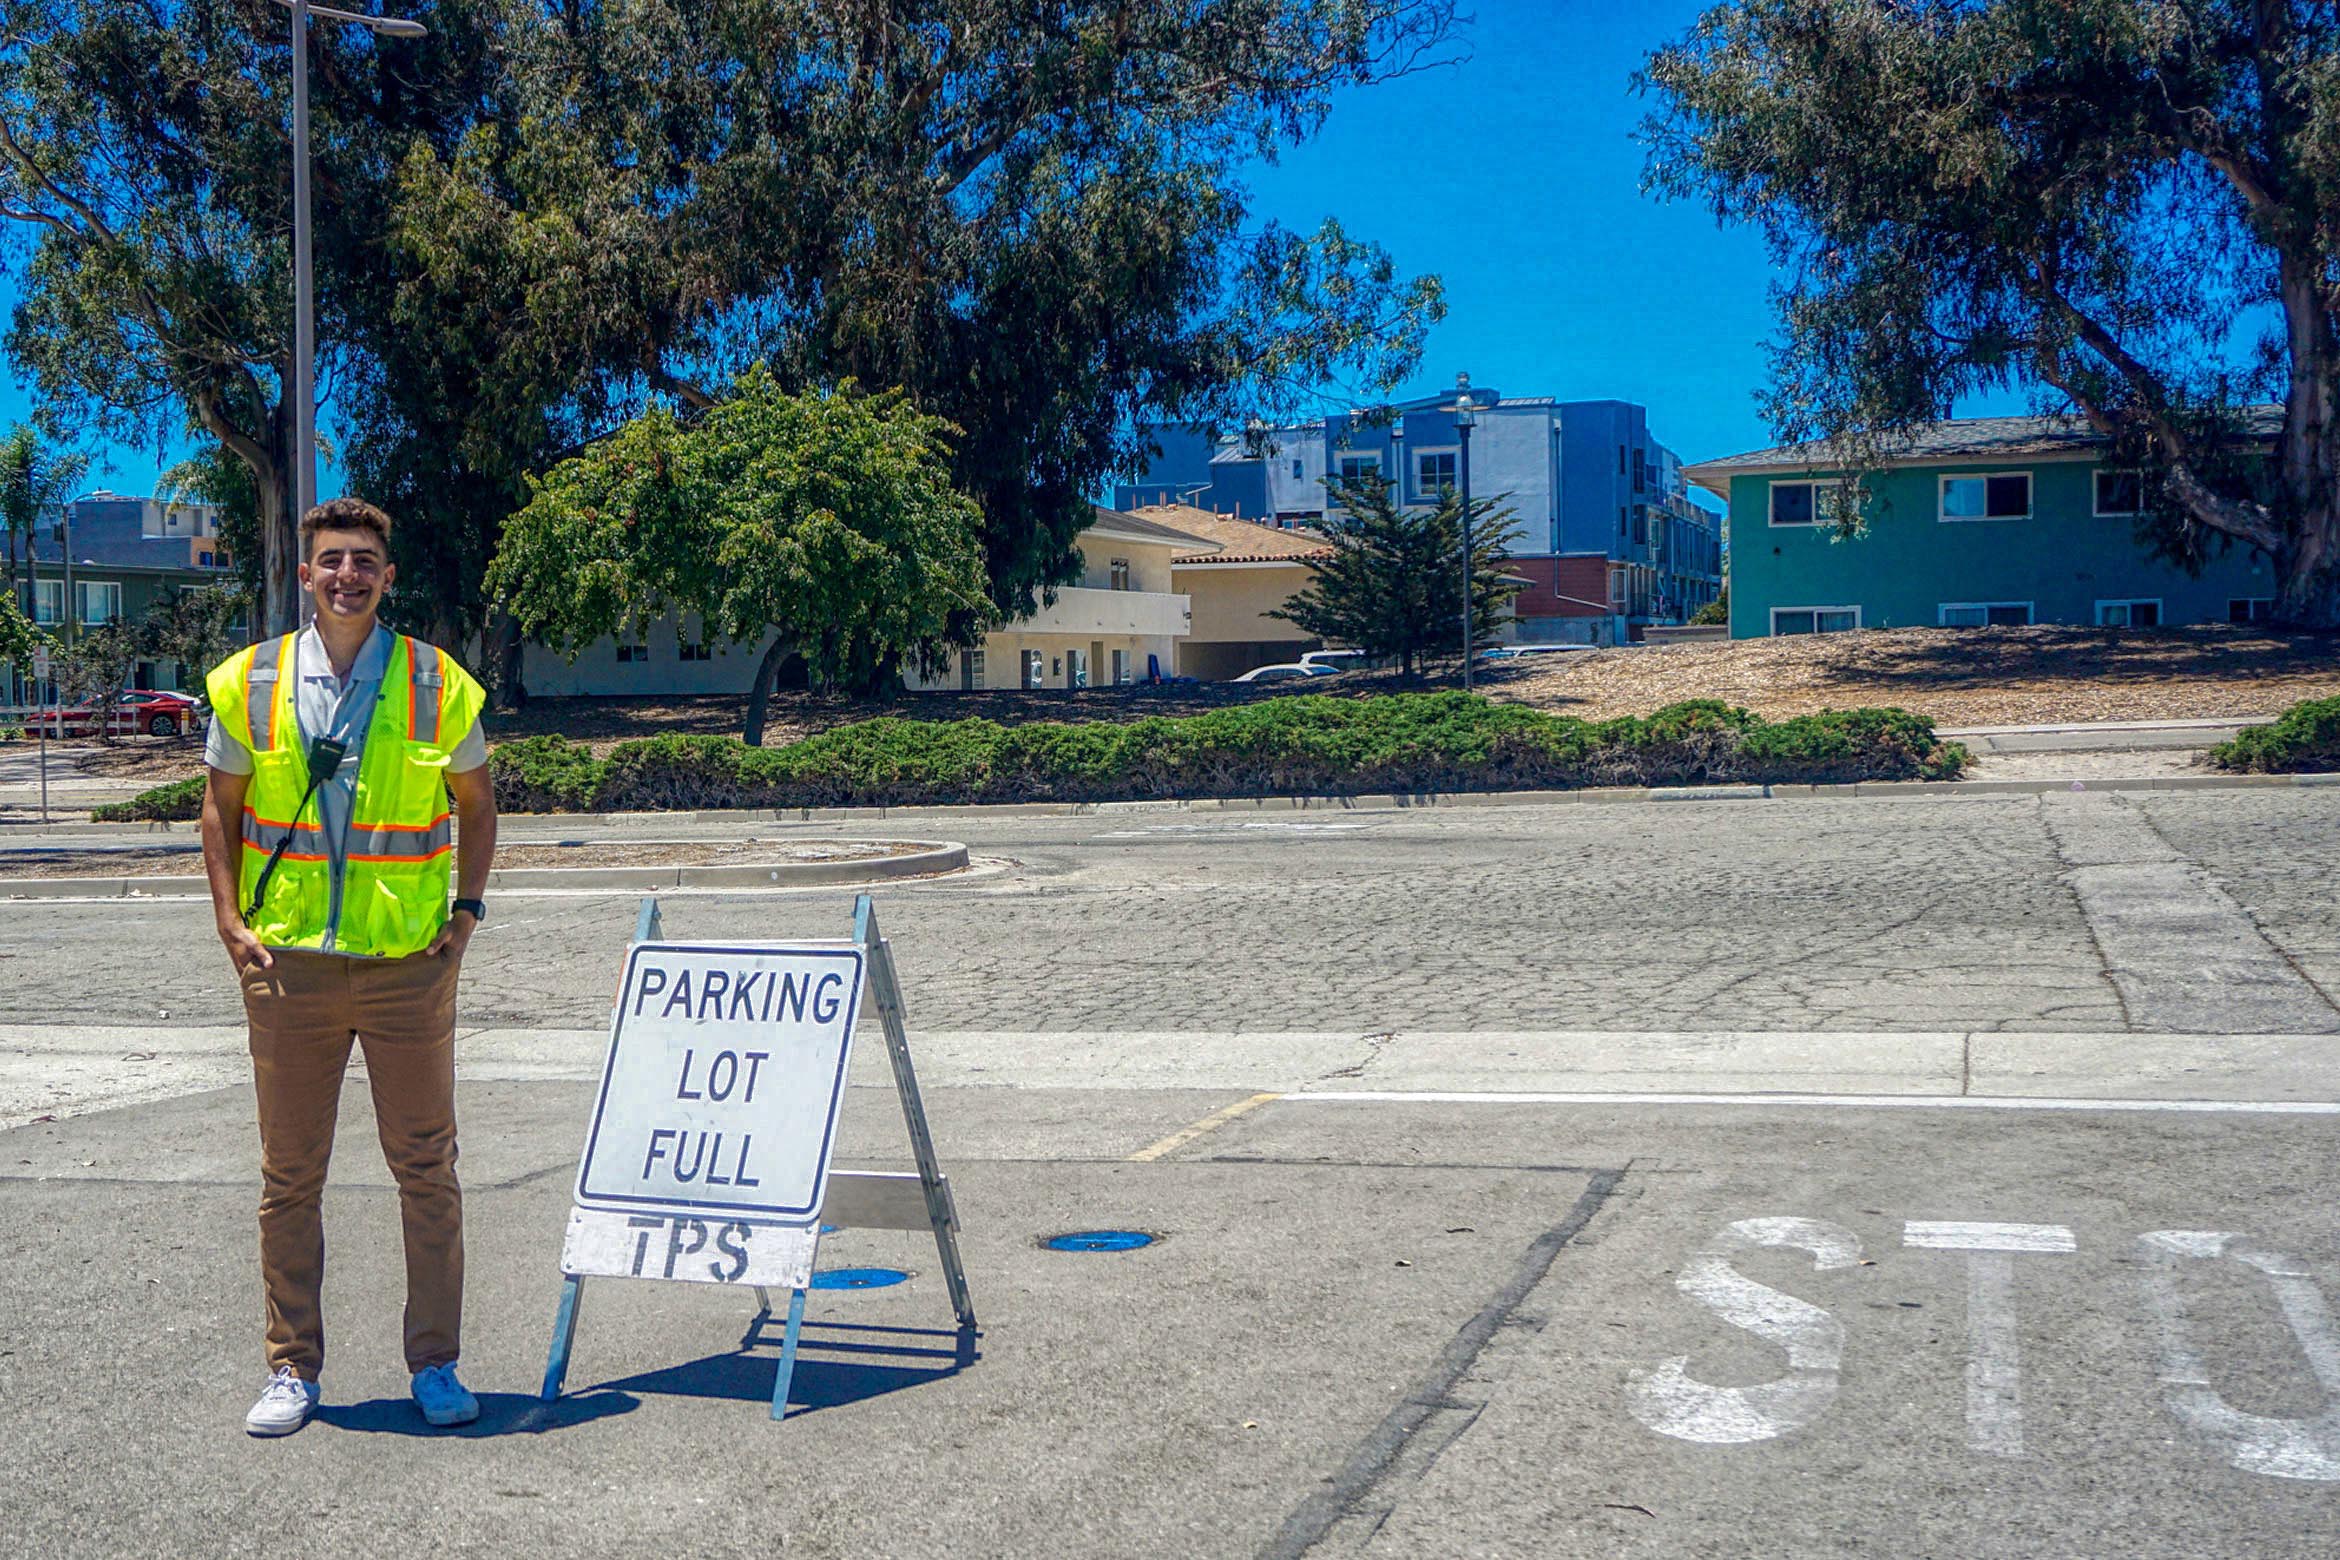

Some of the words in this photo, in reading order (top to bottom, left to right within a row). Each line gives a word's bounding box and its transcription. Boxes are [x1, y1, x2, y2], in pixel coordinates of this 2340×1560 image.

[634, 968, 843, 1024] PARKING
[677, 1049, 769, 1103] LOT
[642, 1129, 760, 1187] FULL
[628, 1216, 752, 1283] TPS
